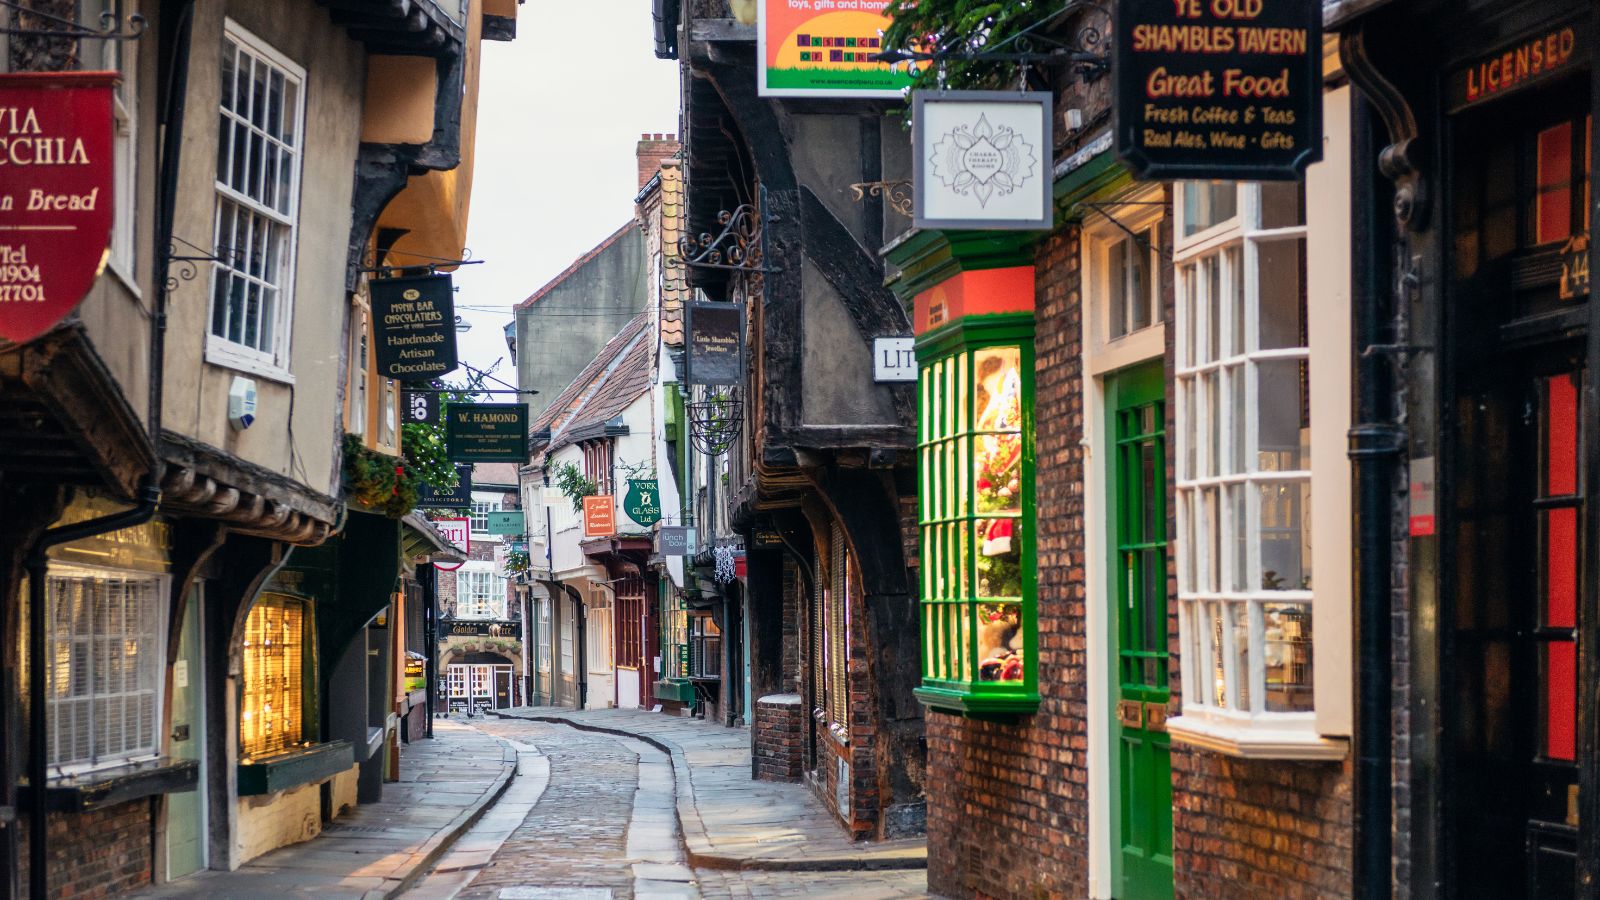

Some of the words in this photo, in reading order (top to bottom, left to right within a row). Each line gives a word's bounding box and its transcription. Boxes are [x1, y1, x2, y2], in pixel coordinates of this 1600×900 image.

[814, 0, 834, 10] gifts
[838, 0, 857, 9] and
[1175, 0, 1202, 19] YE
[1209, 0, 1263, 19] OLD
[797, 34, 879, 47] ESSENCE
[1133, 24, 1235, 53] SHAMBLES
[1237, 27, 1307, 55] TAVERN
[800, 51, 822, 62] OF
[1466, 26, 1575, 102] LICENSED
[1146, 66, 1215, 98] Great
[1223, 67, 1290, 98] Food
[1144, 103, 1189, 123] Fresh
[1191, 106, 1238, 124] Coffee
[1261, 106, 1295, 124] Teas
[1143, 129, 1172, 147] Real
[1210, 131, 1246, 148] Wine
[1260, 131, 1294, 149] Gifts
[27, 187, 99, 211] Bread
[0, 245, 27, 263] Tel
[0, 265, 41, 282] 1904
[390, 302, 415, 313] MONK
[416, 301, 434, 311] BAR
[384, 311, 443, 324] CHOCOLATIERS
[387, 332, 445, 346] Handmade
[712, 336, 735, 344] Shambles
[399, 348, 435, 359] Artisan
[705, 345, 727, 353] Jewellers
[390, 361, 447, 374] Chocolates
[458, 413, 471, 422] W.
[473, 413, 518, 423] HAMOND
[634, 482, 658, 491] YORK
[632, 506, 660, 515] GLASS
[453, 625, 478, 634] Golden
